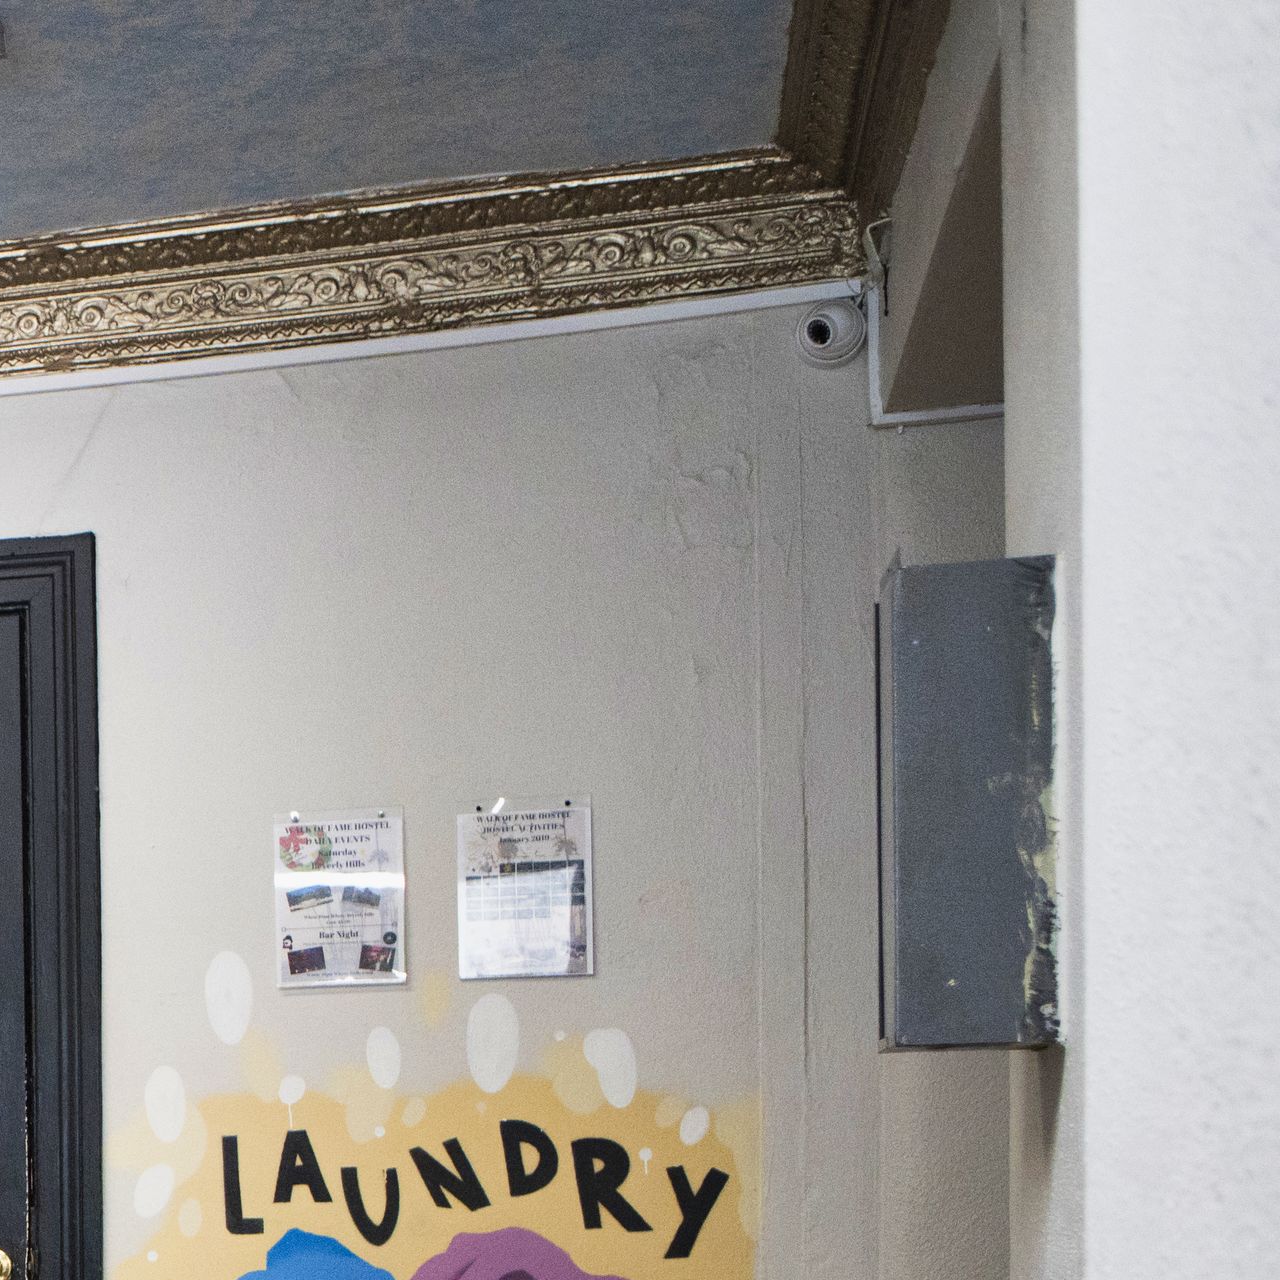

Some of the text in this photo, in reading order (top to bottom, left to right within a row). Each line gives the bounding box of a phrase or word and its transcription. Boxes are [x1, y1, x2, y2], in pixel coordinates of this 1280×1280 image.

[476, 811, 571, 823] WALK OF FAME HOSTEL
[285, 821, 391, 834] WALK OF FAME HOSTEL
[483, 823, 565, 834] HOSTEL ACTIVITIES
[305, 835, 371, 845] DAILY EVENTS
[499, 836, 529, 844] January
[318, 848, 357, 858] Saturday
[311, 859, 366, 871] Beverly Hills
[319, 930, 359, 940] Bar Night
[222, 1119, 730, 1259] LAUNDRY
